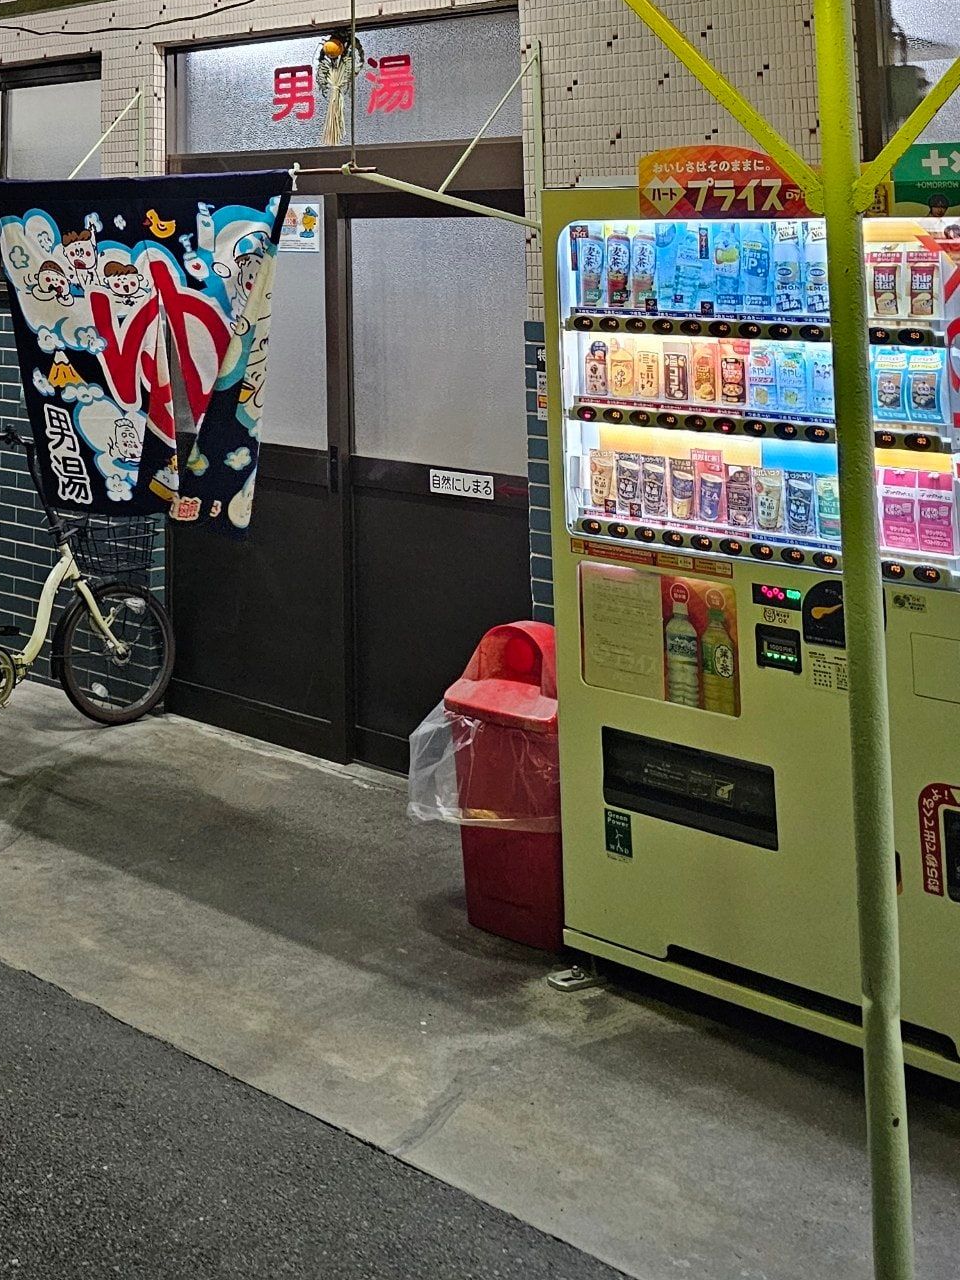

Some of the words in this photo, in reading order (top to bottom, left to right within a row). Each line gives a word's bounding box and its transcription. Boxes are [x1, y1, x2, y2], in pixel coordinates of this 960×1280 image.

[652, 159, 771, 173] おいしさはそのままに。
[652, 187, 678, 201] ハート
[687, 177, 784, 212] プライス
[612, 246, 622, 268] 麦茶
[874, 272, 895, 284] chip
[911, 272, 932, 284] chip
[874, 280, 895, 290] star
[911, 280, 932, 290] star
[669, 367, 680, 395] ココア
[47, 406, 90, 503] 男湯
[432, 473, 493, 495] 自然にしまる
[701, 488, 719, 501] TEA
[607, 810, 628, 821] Green
[607, 816, 629, 828] Power
